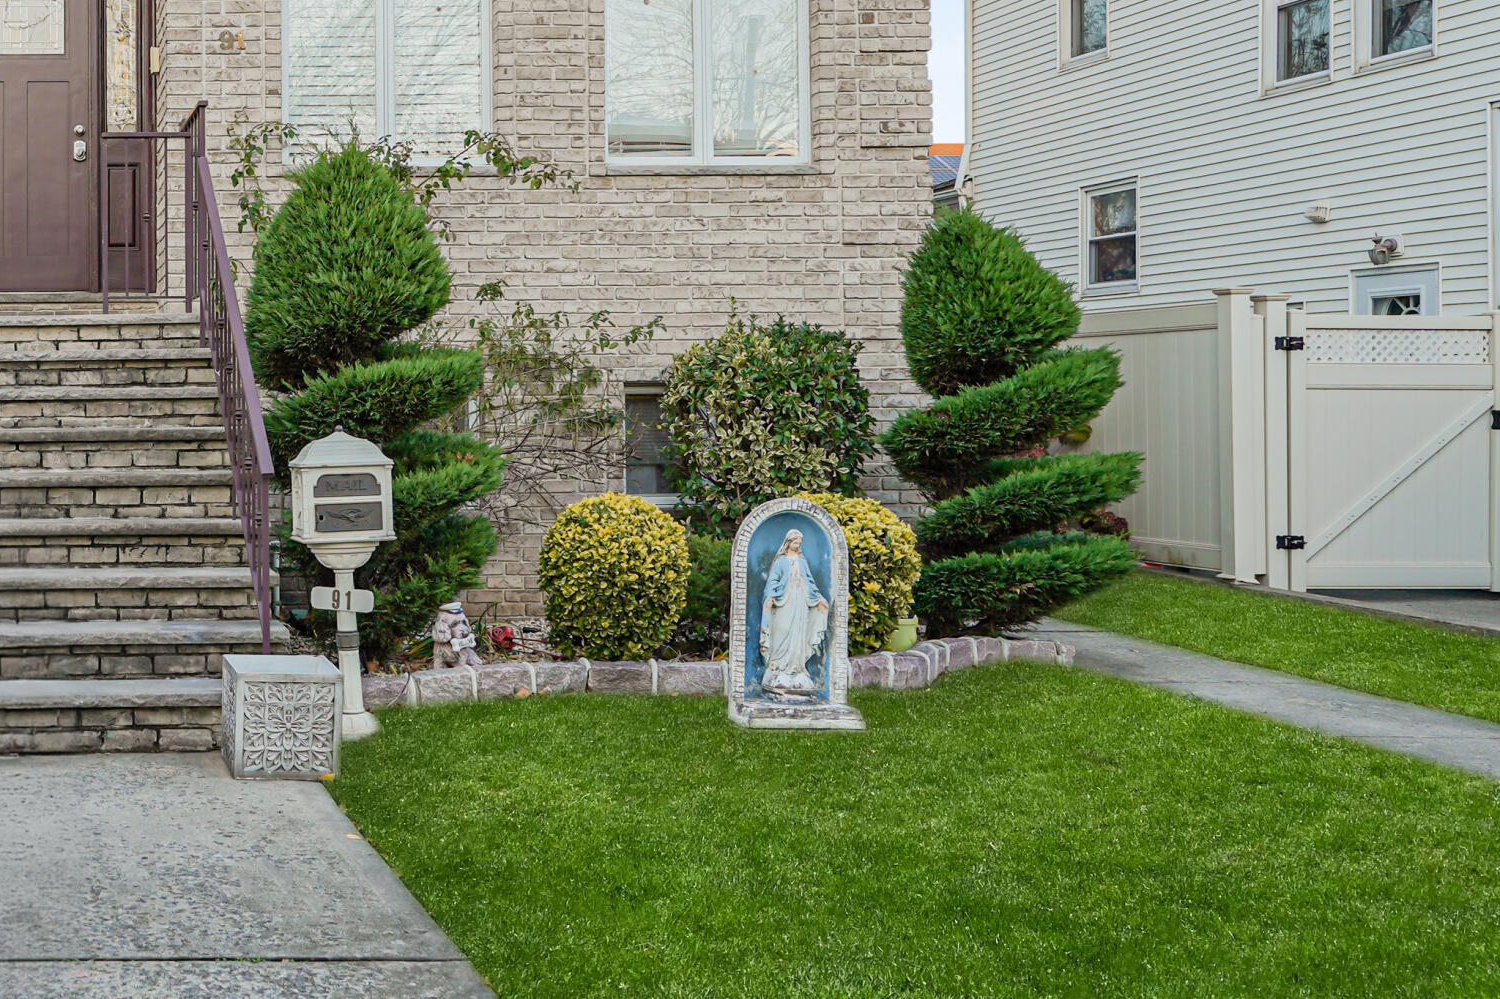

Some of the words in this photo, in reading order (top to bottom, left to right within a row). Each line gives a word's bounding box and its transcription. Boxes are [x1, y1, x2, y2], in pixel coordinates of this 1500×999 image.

[219, 30, 245, 50] 91
[326, 479, 368, 491] MAIL
[332, 589, 351, 610] 91
